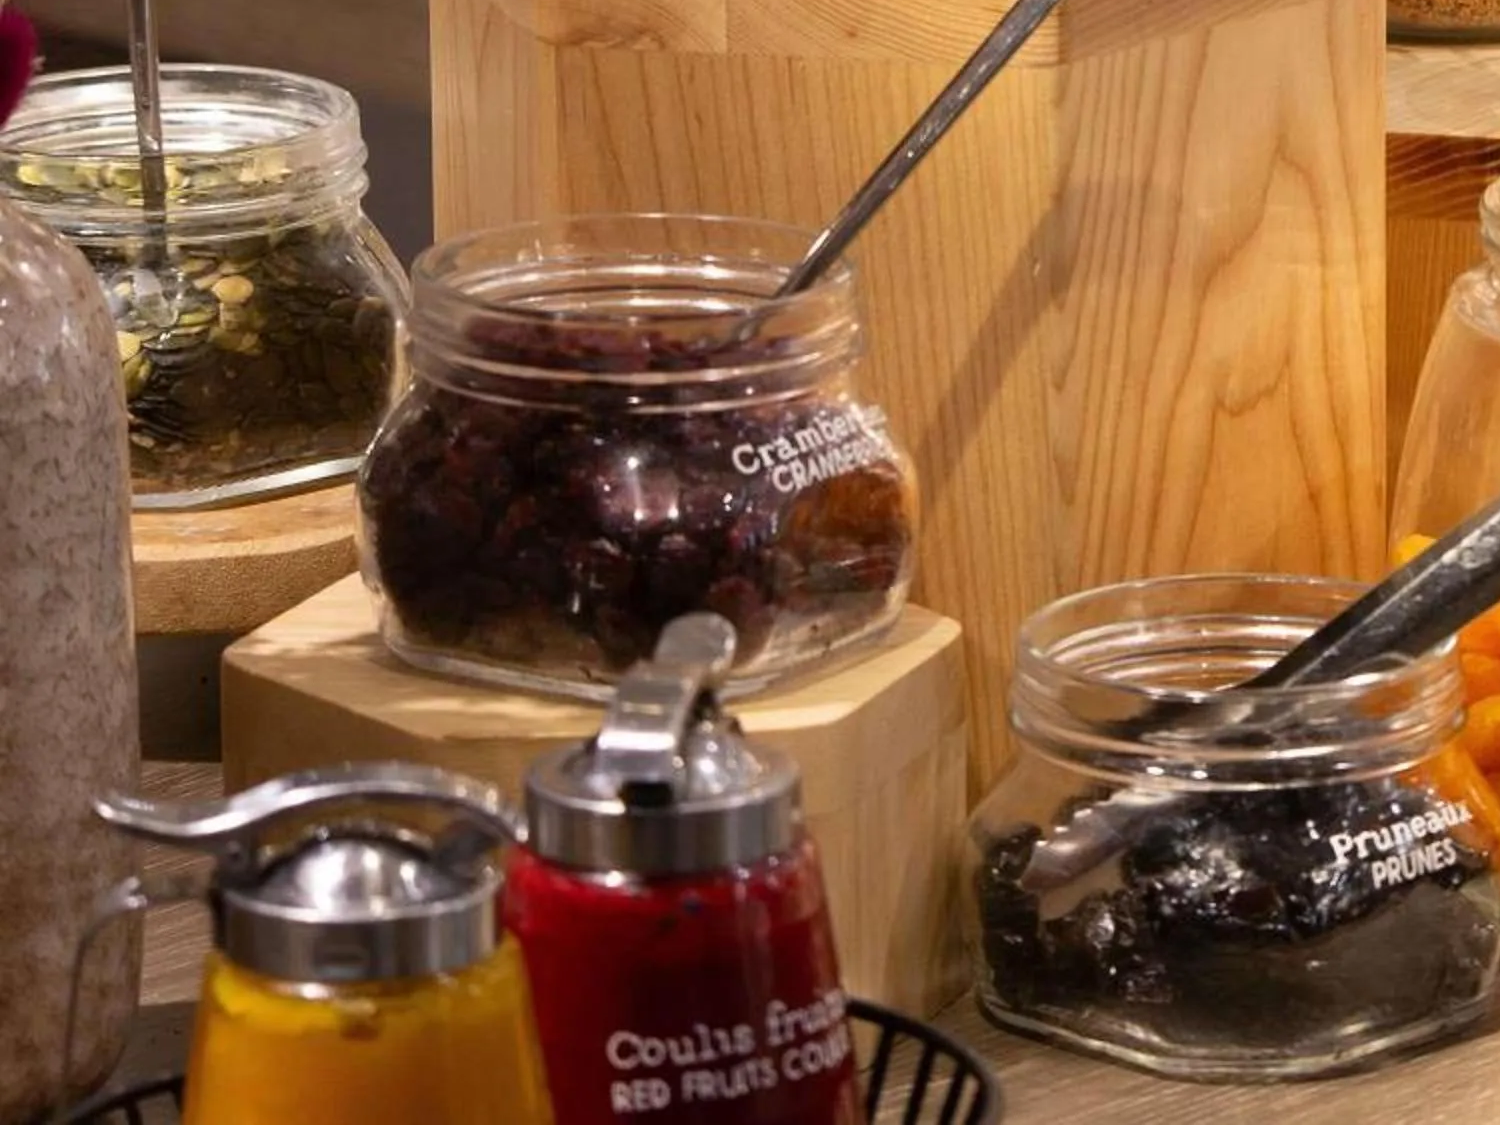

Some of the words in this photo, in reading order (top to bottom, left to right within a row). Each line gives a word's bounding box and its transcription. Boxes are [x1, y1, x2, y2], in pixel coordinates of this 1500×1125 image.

[1329, 801, 1474, 865] Pruneaux
[1370, 837, 1458, 890] PRUNES
[605, 1022, 756, 1071] Coulis
[610, 1077, 672, 1114] RED
[680, 1056, 779, 1103] FRUITS
